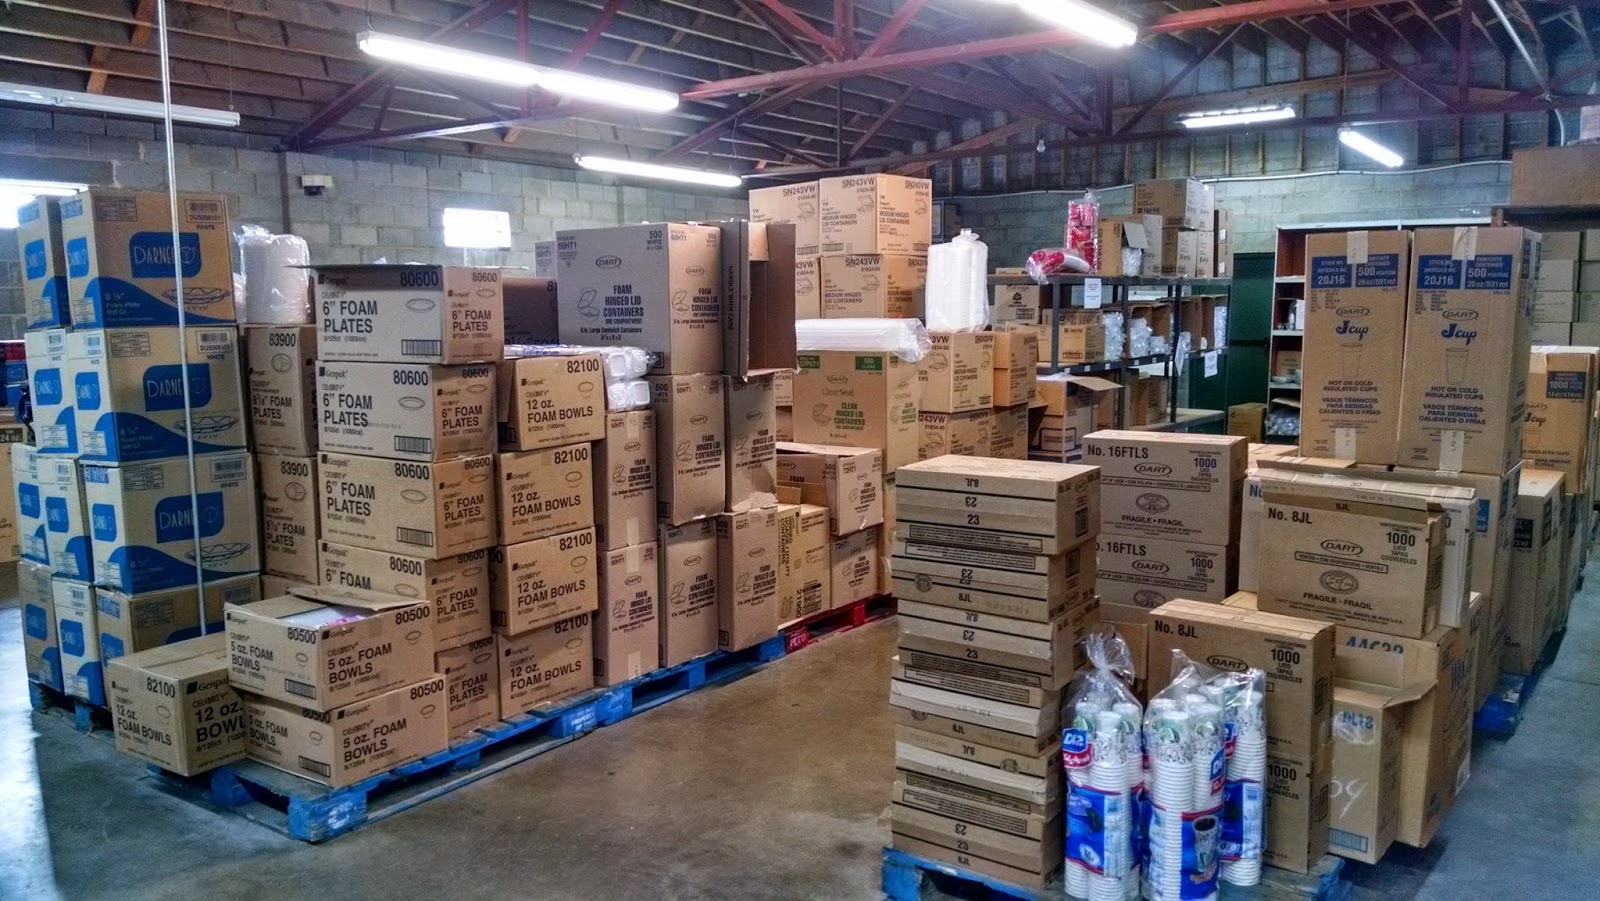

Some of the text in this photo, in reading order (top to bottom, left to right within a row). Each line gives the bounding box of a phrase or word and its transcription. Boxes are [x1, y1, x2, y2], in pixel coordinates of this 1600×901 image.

[783, 184, 816, 196] SN243VW
[842, 178, 874, 188] SN243VW
[905, 180, 930, 190] SN243VW
[650, 230, 662, 238] 500
[846, 258, 880, 267] SN243VW
[400, 271, 438, 286] 80600
[472, 272, 497, 282] 80600
[1358, 267, 1376, 276] 500
[1468, 268, 1486, 278] 500
[1318, 276, 1346, 285] 20J16
[1424, 276, 1454, 286] 20J16
[614, 284, 632, 294] FOAM
[340, 301, 378, 315] FOAM
[605, 296, 642, 306] HINGED LID
[465, 310, 491, 320] FOAM
[604, 307, 644, 317] CONTAINERS
[324, 319, 372, 333] PLATES
[453, 322, 488, 331] PLATES
[269, 333, 296, 347] 83900
[462, 368, 488, 378] 80600
[567, 359, 599, 374] 82100
[394, 370, 428, 385] 80600
[147, 379, 183, 397] DARNE
[270, 396, 292, 407] FOAM
[339, 394, 372, 410] FOAM
[526, 399, 554, 410] 12 oz.
[842, 402, 858, 410] CLEAR
[254, 408, 282, 419] PLATES
[455, 405, 482, 416] FOAM
[528, 406, 594, 424] FOAM BOWLS
[324, 410, 368, 426] PLATES
[442, 417, 479, 429] PLATES
[834, 418, 866, 426] CONTAINERS
[554, 448, 588, 464] 82100
[695, 450, 722, 460] CONTAINERS
[1088, 445, 1148, 459] No. 16FTLS
[281, 462, 308, 476] 83900
[464, 457, 490, 470] 80600
[1193, 458, 1217, 468] 1000
[395, 462, 430, 480] 80600
[965, 478, 979, 488] 8JL
[342, 482, 375, 500] FOAM
[512, 491, 540, 504] 12 oz.
[328, 497, 371, 516] PLATES
[457, 495, 484, 508] FOAM
[512, 495, 580, 518] FOAM BOWLS
[965, 497, 977, 508] 23
[444, 506, 480, 522] PLATES
[968, 514, 980, 526] 23
[1122, 514, 1184, 526] FRAGILE FRAGIL
[1268, 508, 1312, 524] No. 8JL
[282, 524, 305, 536] FOAM
[267, 532, 294, 547] PLATES
[560, 532, 592, 551] 82100
[1386, 532, 1416, 547] 1000
[1106, 542, 1146, 556] 16FTLS
[1326, 542, 1358, 553] DART
[1392, 550, 1408, 558] TAPAS
[390, 556, 422, 576] 80600
[1190, 558, 1213, 568] 1000
[1381, 555, 1418, 565] COUVERCLES
[340, 571, 371, 590] FOAM
[518, 580, 546, 594] 12 oz.
[450, 587, 478, 601] FOAM
[518, 580, 586, 608] FOAM BOWLS
[1303, 592, 1372, 610] FRAGILE FRAGIL
[437, 599, 474, 617] PLATES
[396, 606, 430, 625] 80500
[554, 614, 588, 634] 82100
[1155, 620, 1198, 638] No. 8JL
[288, 627, 316, 645] 80500
[790, 632, 806, 647] PECO
[963, 630, 974, 641] 23
[250, 646, 274, 661] FOAM
[328, 659, 335, 670] 5
[358, 642, 392, 662] FOAM
[1270, 648, 1300, 664] 1000
[232, 654, 260, 671] BOWLS
[1212, 658, 1244, 670] DART
[329, 662, 372, 684] BOWLS
[510, 664, 540, 678] 12 oz.
[510, 660, 582, 692] FOAM BOWLS
[1267, 672, 1302, 684] COUVERCLES
[1276, 668, 1293, 676] TAPAS
[146, 677, 176, 698] 82100
[410, 679, 444, 700] 80500
[116, 704, 124, 716] 12
[196, 702, 244, 723] 12 oz.
[118, 718, 172, 746] FOAM BOWLS
[196, 716, 246, 743] BOWL
[343, 737, 350, 748] 5
[374, 718, 407, 738] FOAM
[344, 739, 388, 762] BOWLS
[962, 745, 976, 756] 8JL
[1268, 764, 1297, 780] 1000
[955, 823, 967, 836] 23
